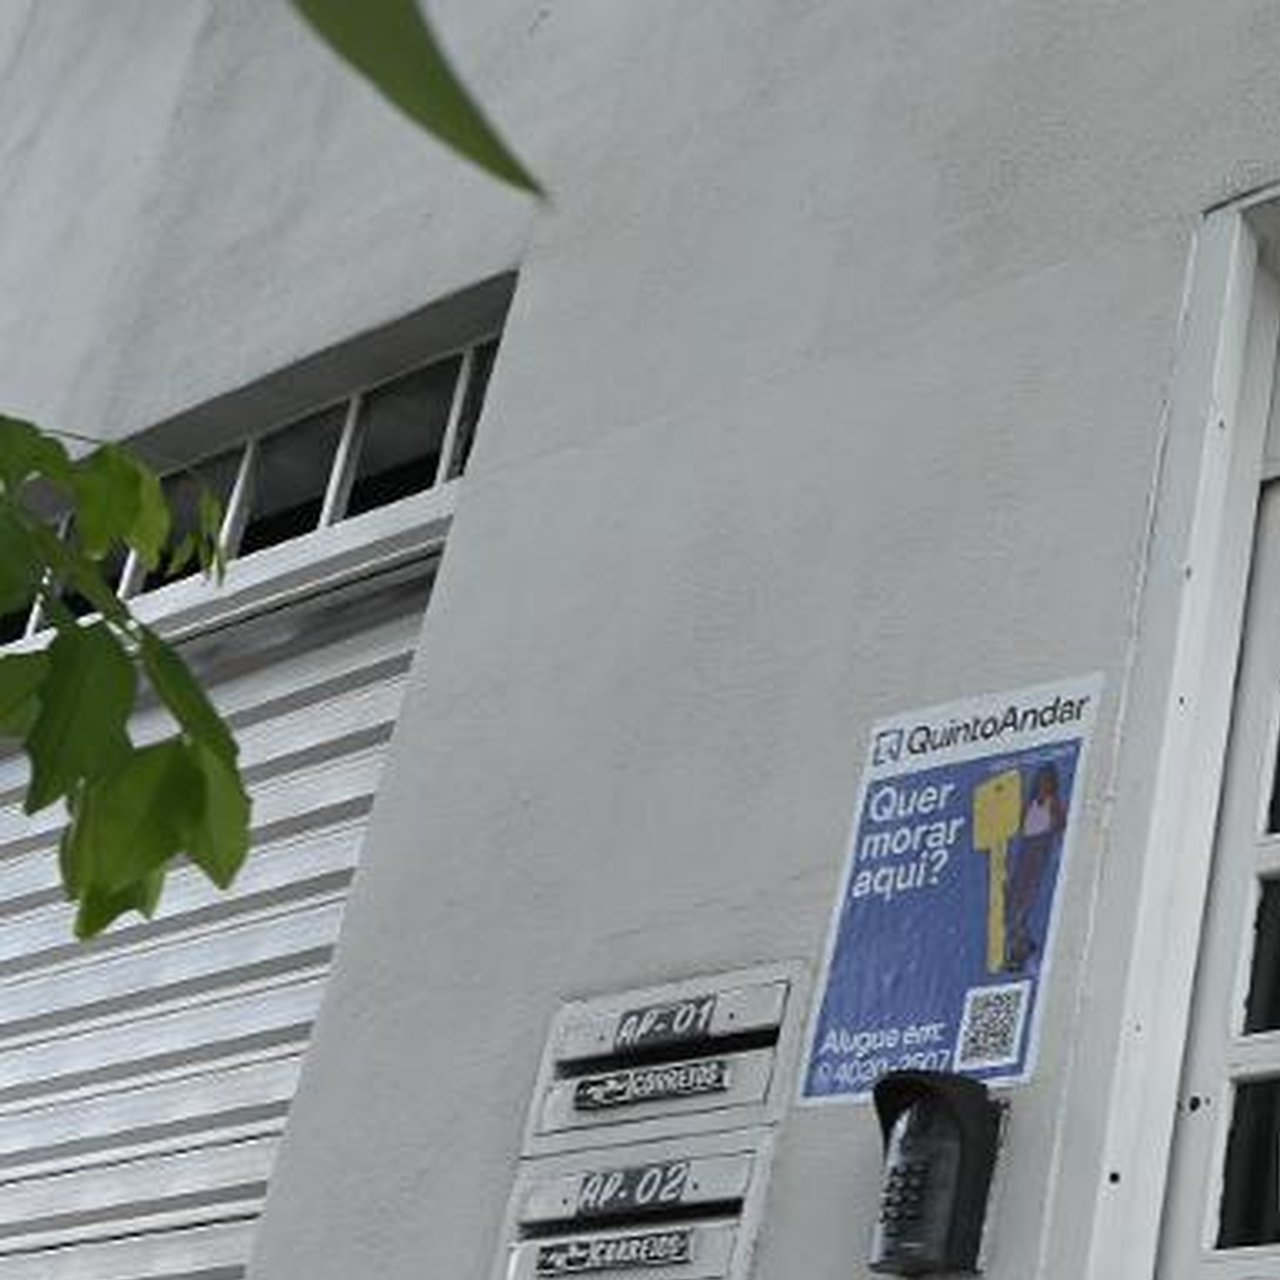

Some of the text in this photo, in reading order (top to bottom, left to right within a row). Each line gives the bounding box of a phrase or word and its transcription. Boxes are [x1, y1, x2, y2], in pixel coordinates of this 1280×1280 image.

[907, 696, 1091, 755] QuintoAndar
[870, 784, 955, 823] Quer
[860, 816, 966, 861] morar
[852, 849, 948, 901] aqui?
[819, 1025, 899, 1058] Alugue
